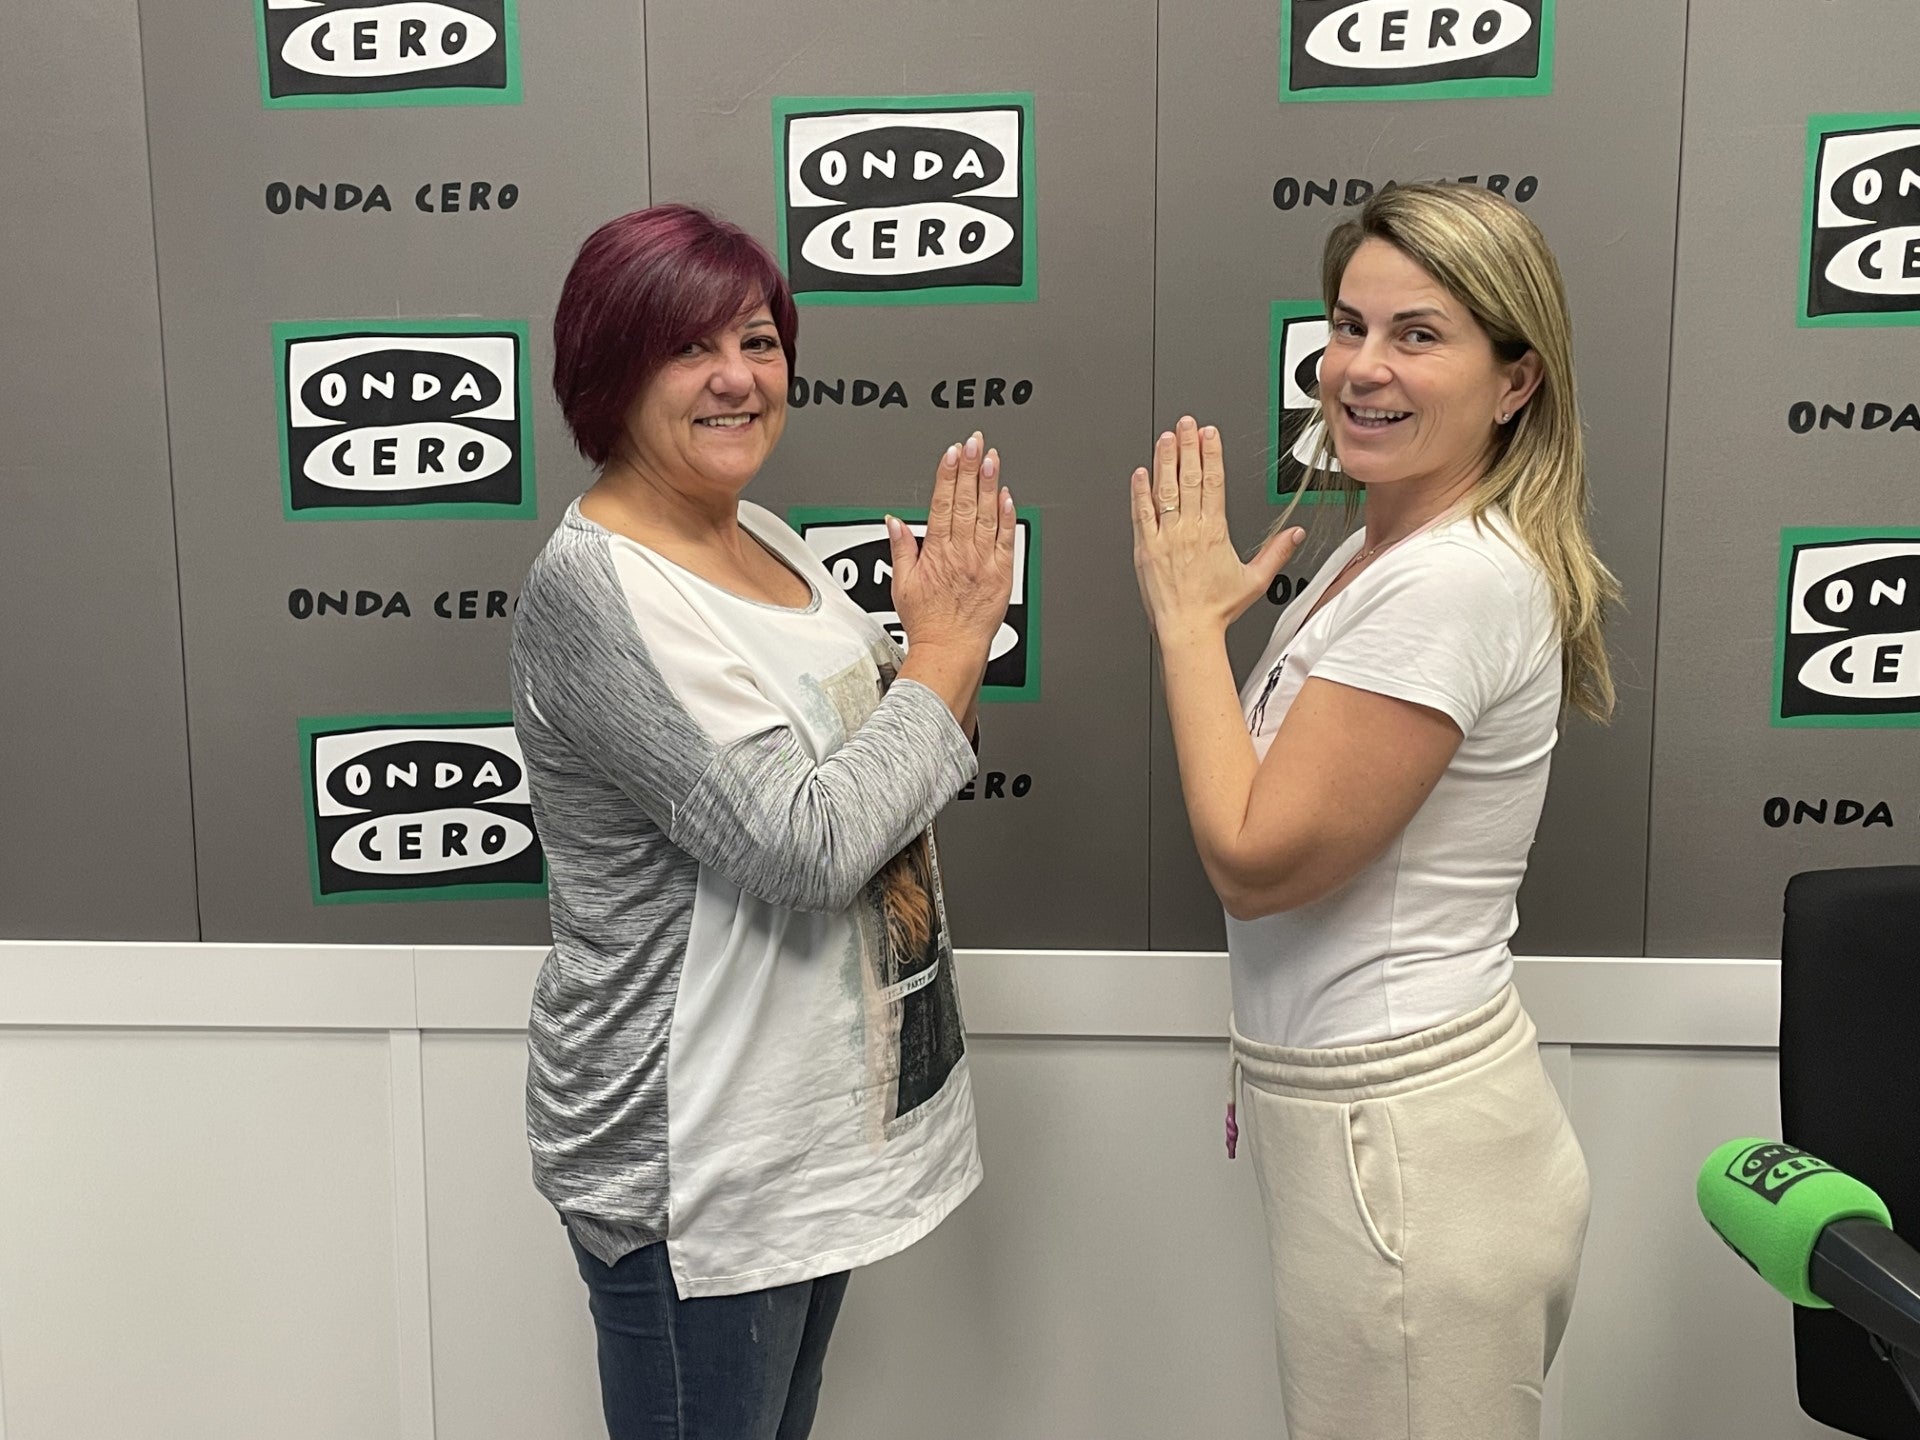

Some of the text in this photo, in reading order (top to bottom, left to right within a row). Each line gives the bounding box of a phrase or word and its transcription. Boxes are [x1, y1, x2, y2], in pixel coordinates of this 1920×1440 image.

[311, 20, 468, 61] CERO
[1337, 9, 1502, 52] CERO
[819, 148, 985, 185] ONDA
[266, 182, 519, 214] ONDA CERO
[831, 219, 986, 259] CERO
[320, 371, 482, 406] ONDA
[787, 377, 1033, 408] ONDA CERO
[1789, 402, 1920, 434] ONDA
[332, 438, 485, 476] CERO
[289, 589, 519, 619] ONDA CER
[1825, 578, 1906, 612] ON
[1830, 645, 1903, 684] CE
[345, 761, 502, 796] ONDA
[1764, 797, 1893, 827] ONDA
[359, 823, 506, 861] CERO
